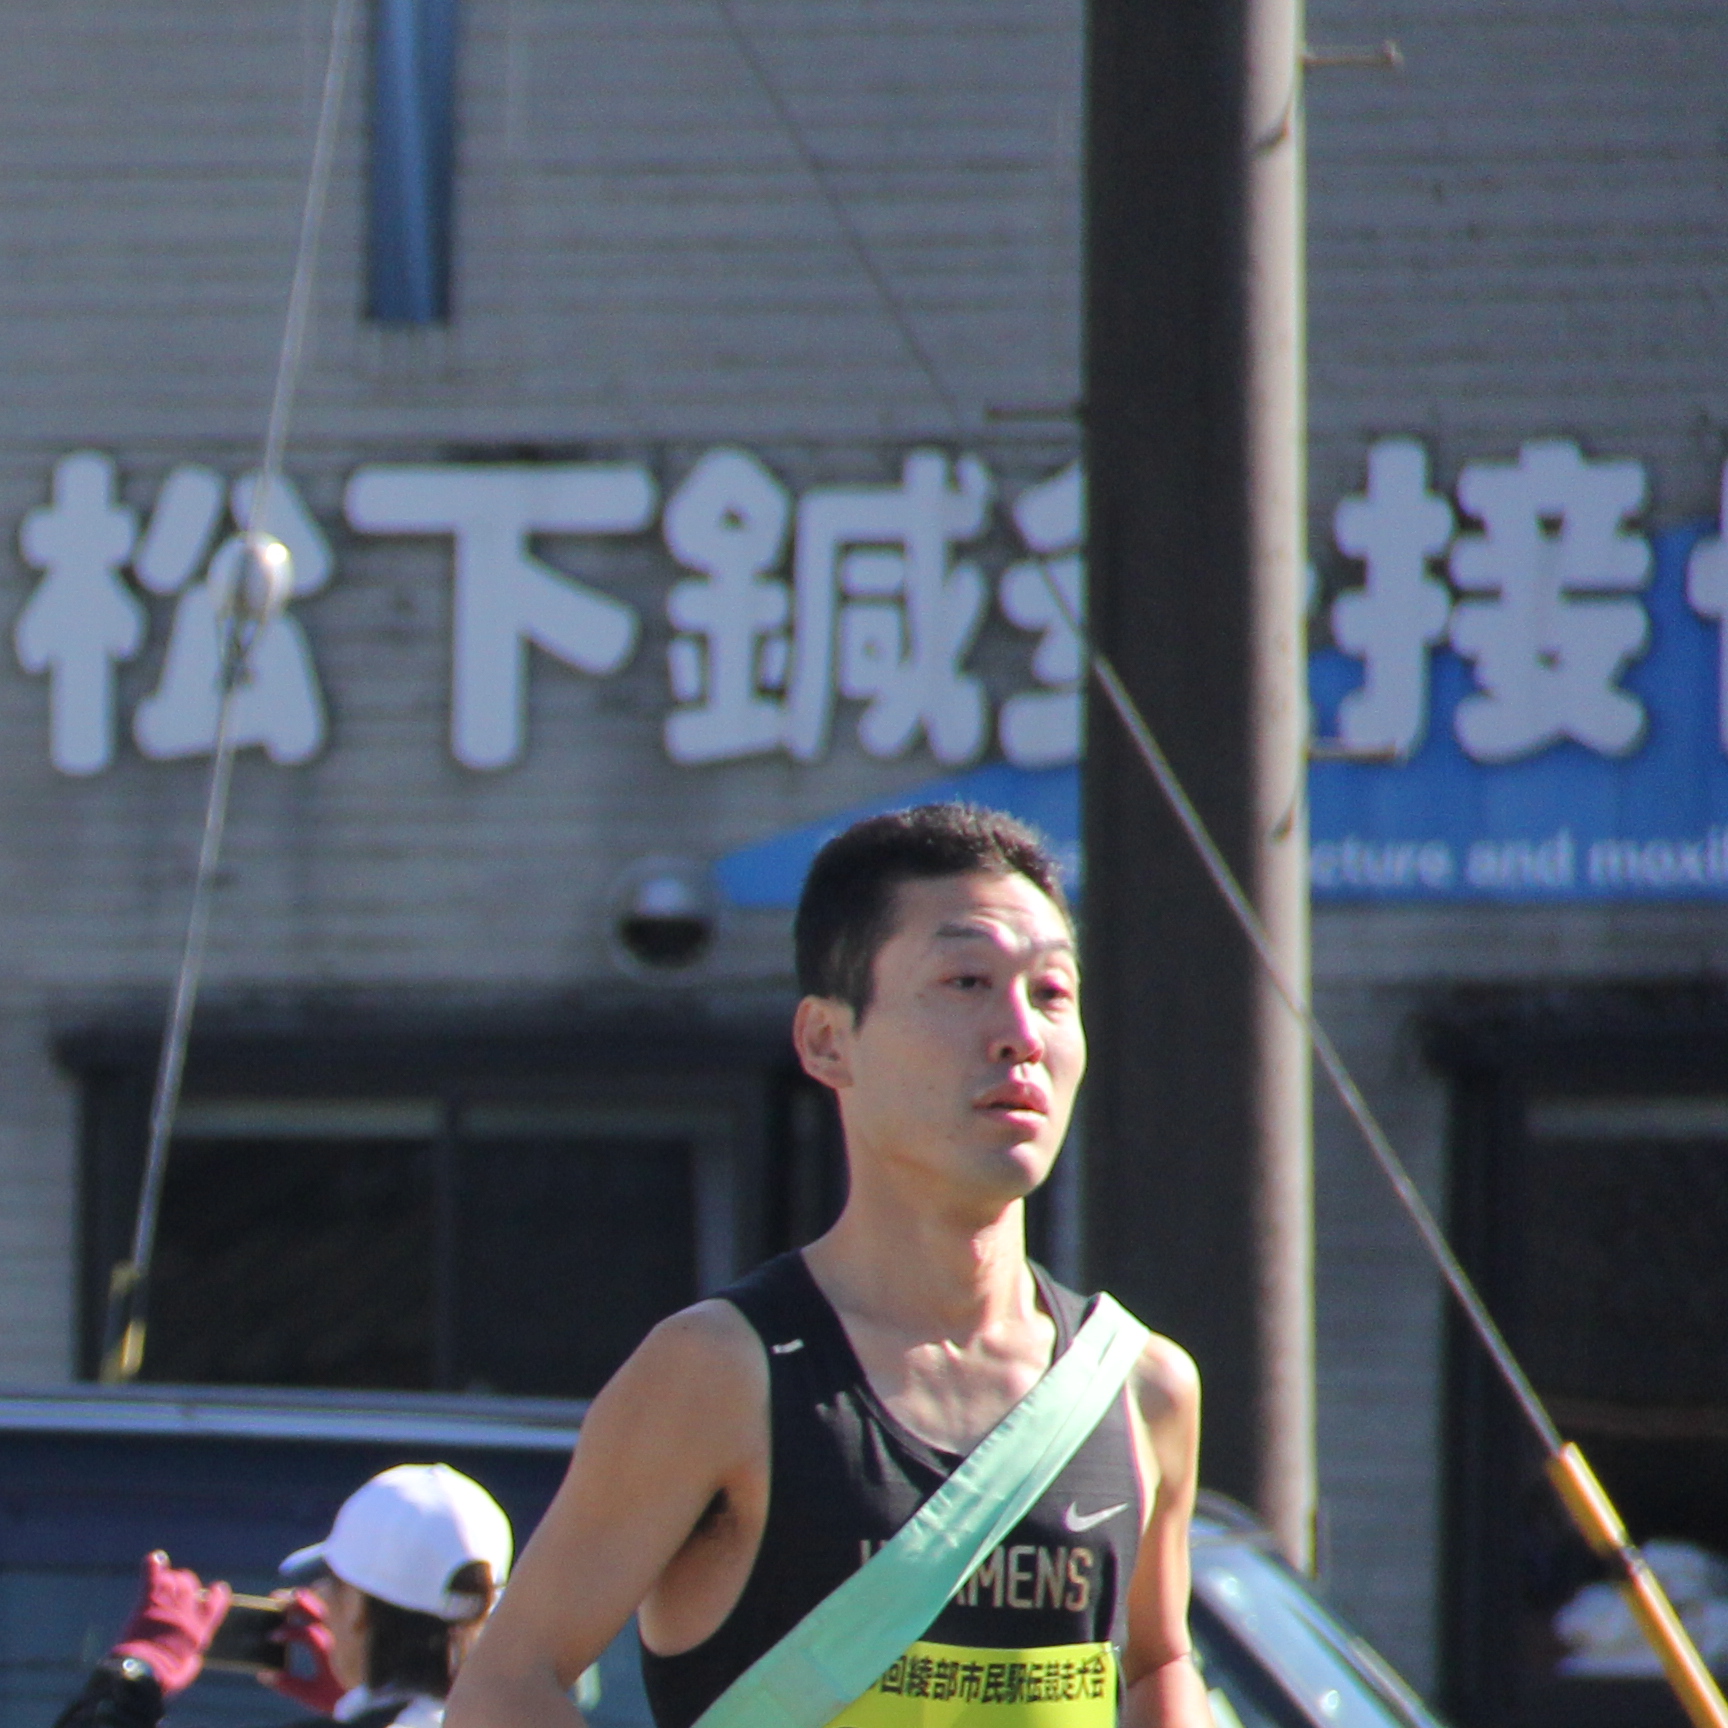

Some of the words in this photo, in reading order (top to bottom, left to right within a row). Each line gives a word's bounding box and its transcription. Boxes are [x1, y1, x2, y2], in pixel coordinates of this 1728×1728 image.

[14, 438, 1728, 775] 松下鍼接
[1468, 826, 1574, 886] and
